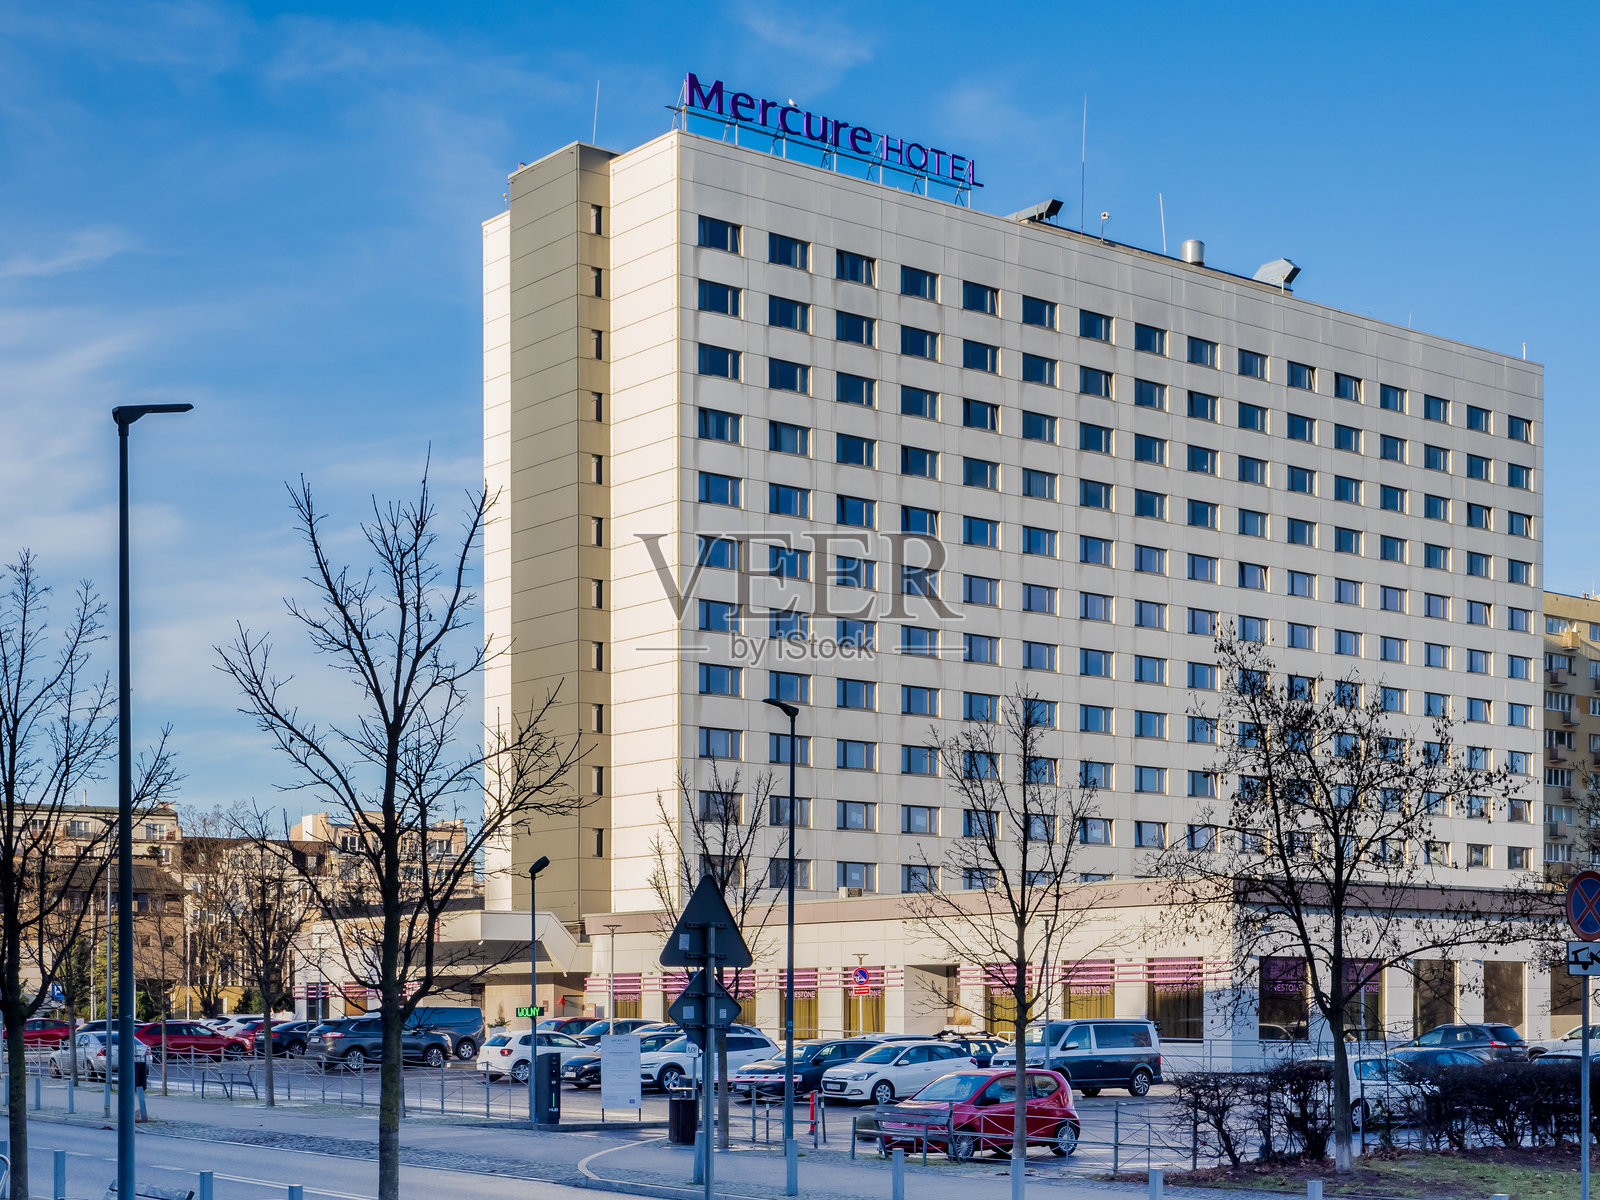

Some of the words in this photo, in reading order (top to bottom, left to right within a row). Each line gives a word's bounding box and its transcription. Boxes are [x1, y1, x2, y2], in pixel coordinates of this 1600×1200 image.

[685, 72, 872, 155] Mercure
[883, 134, 984, 187] HOTEL
[1069, 985, 1110, 994] WINESTONE
[517, 1007, 540, 1017] WOLNY
